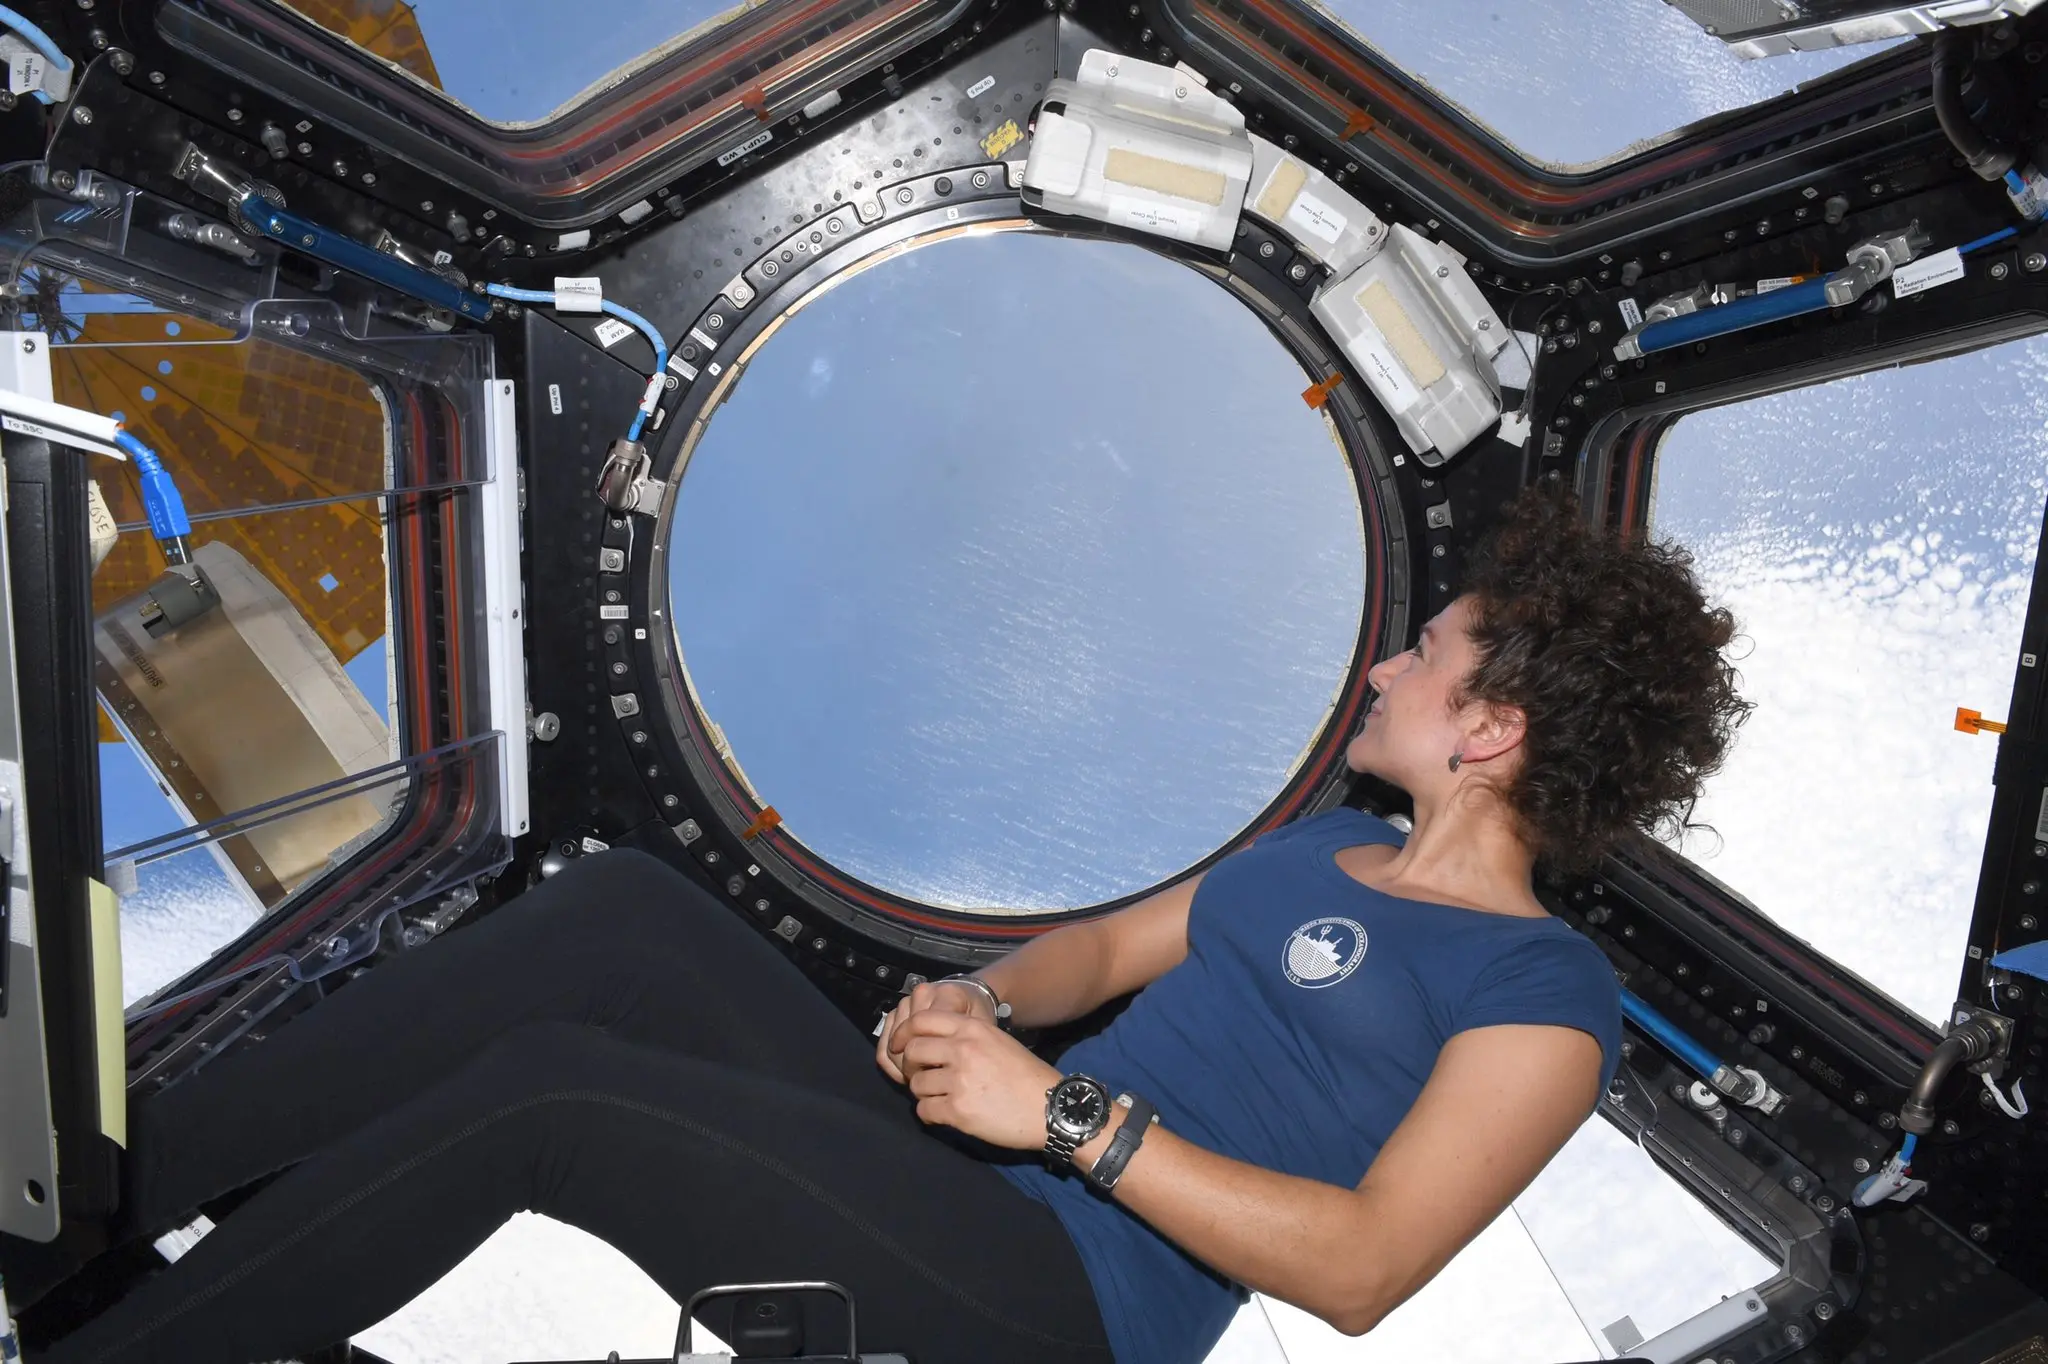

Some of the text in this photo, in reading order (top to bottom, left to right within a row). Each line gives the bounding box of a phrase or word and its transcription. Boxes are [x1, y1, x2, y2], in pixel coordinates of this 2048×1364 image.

[983, 79, 992, 87] Up
[1300, 203, 1313, 215] Cover
[1157, 216, 1178, 225] Vacuum
[1321, 218, 1338, 231] Vacuum
[1903, 277, 1927, 288] Radiation
[1927, 267, 1959, 280] Environment
[610, 328, 626, 339] RAM
[1370, 352, 1381, 365] Cover
[1386, 374, 1399, 391] Vacuum
[551, 387, 557, 396] Up
[6, 419, 43, 435] To SSC
[132, 653, 163, 688] SHUTTER
[193, 1228, 203, 1238] TO
